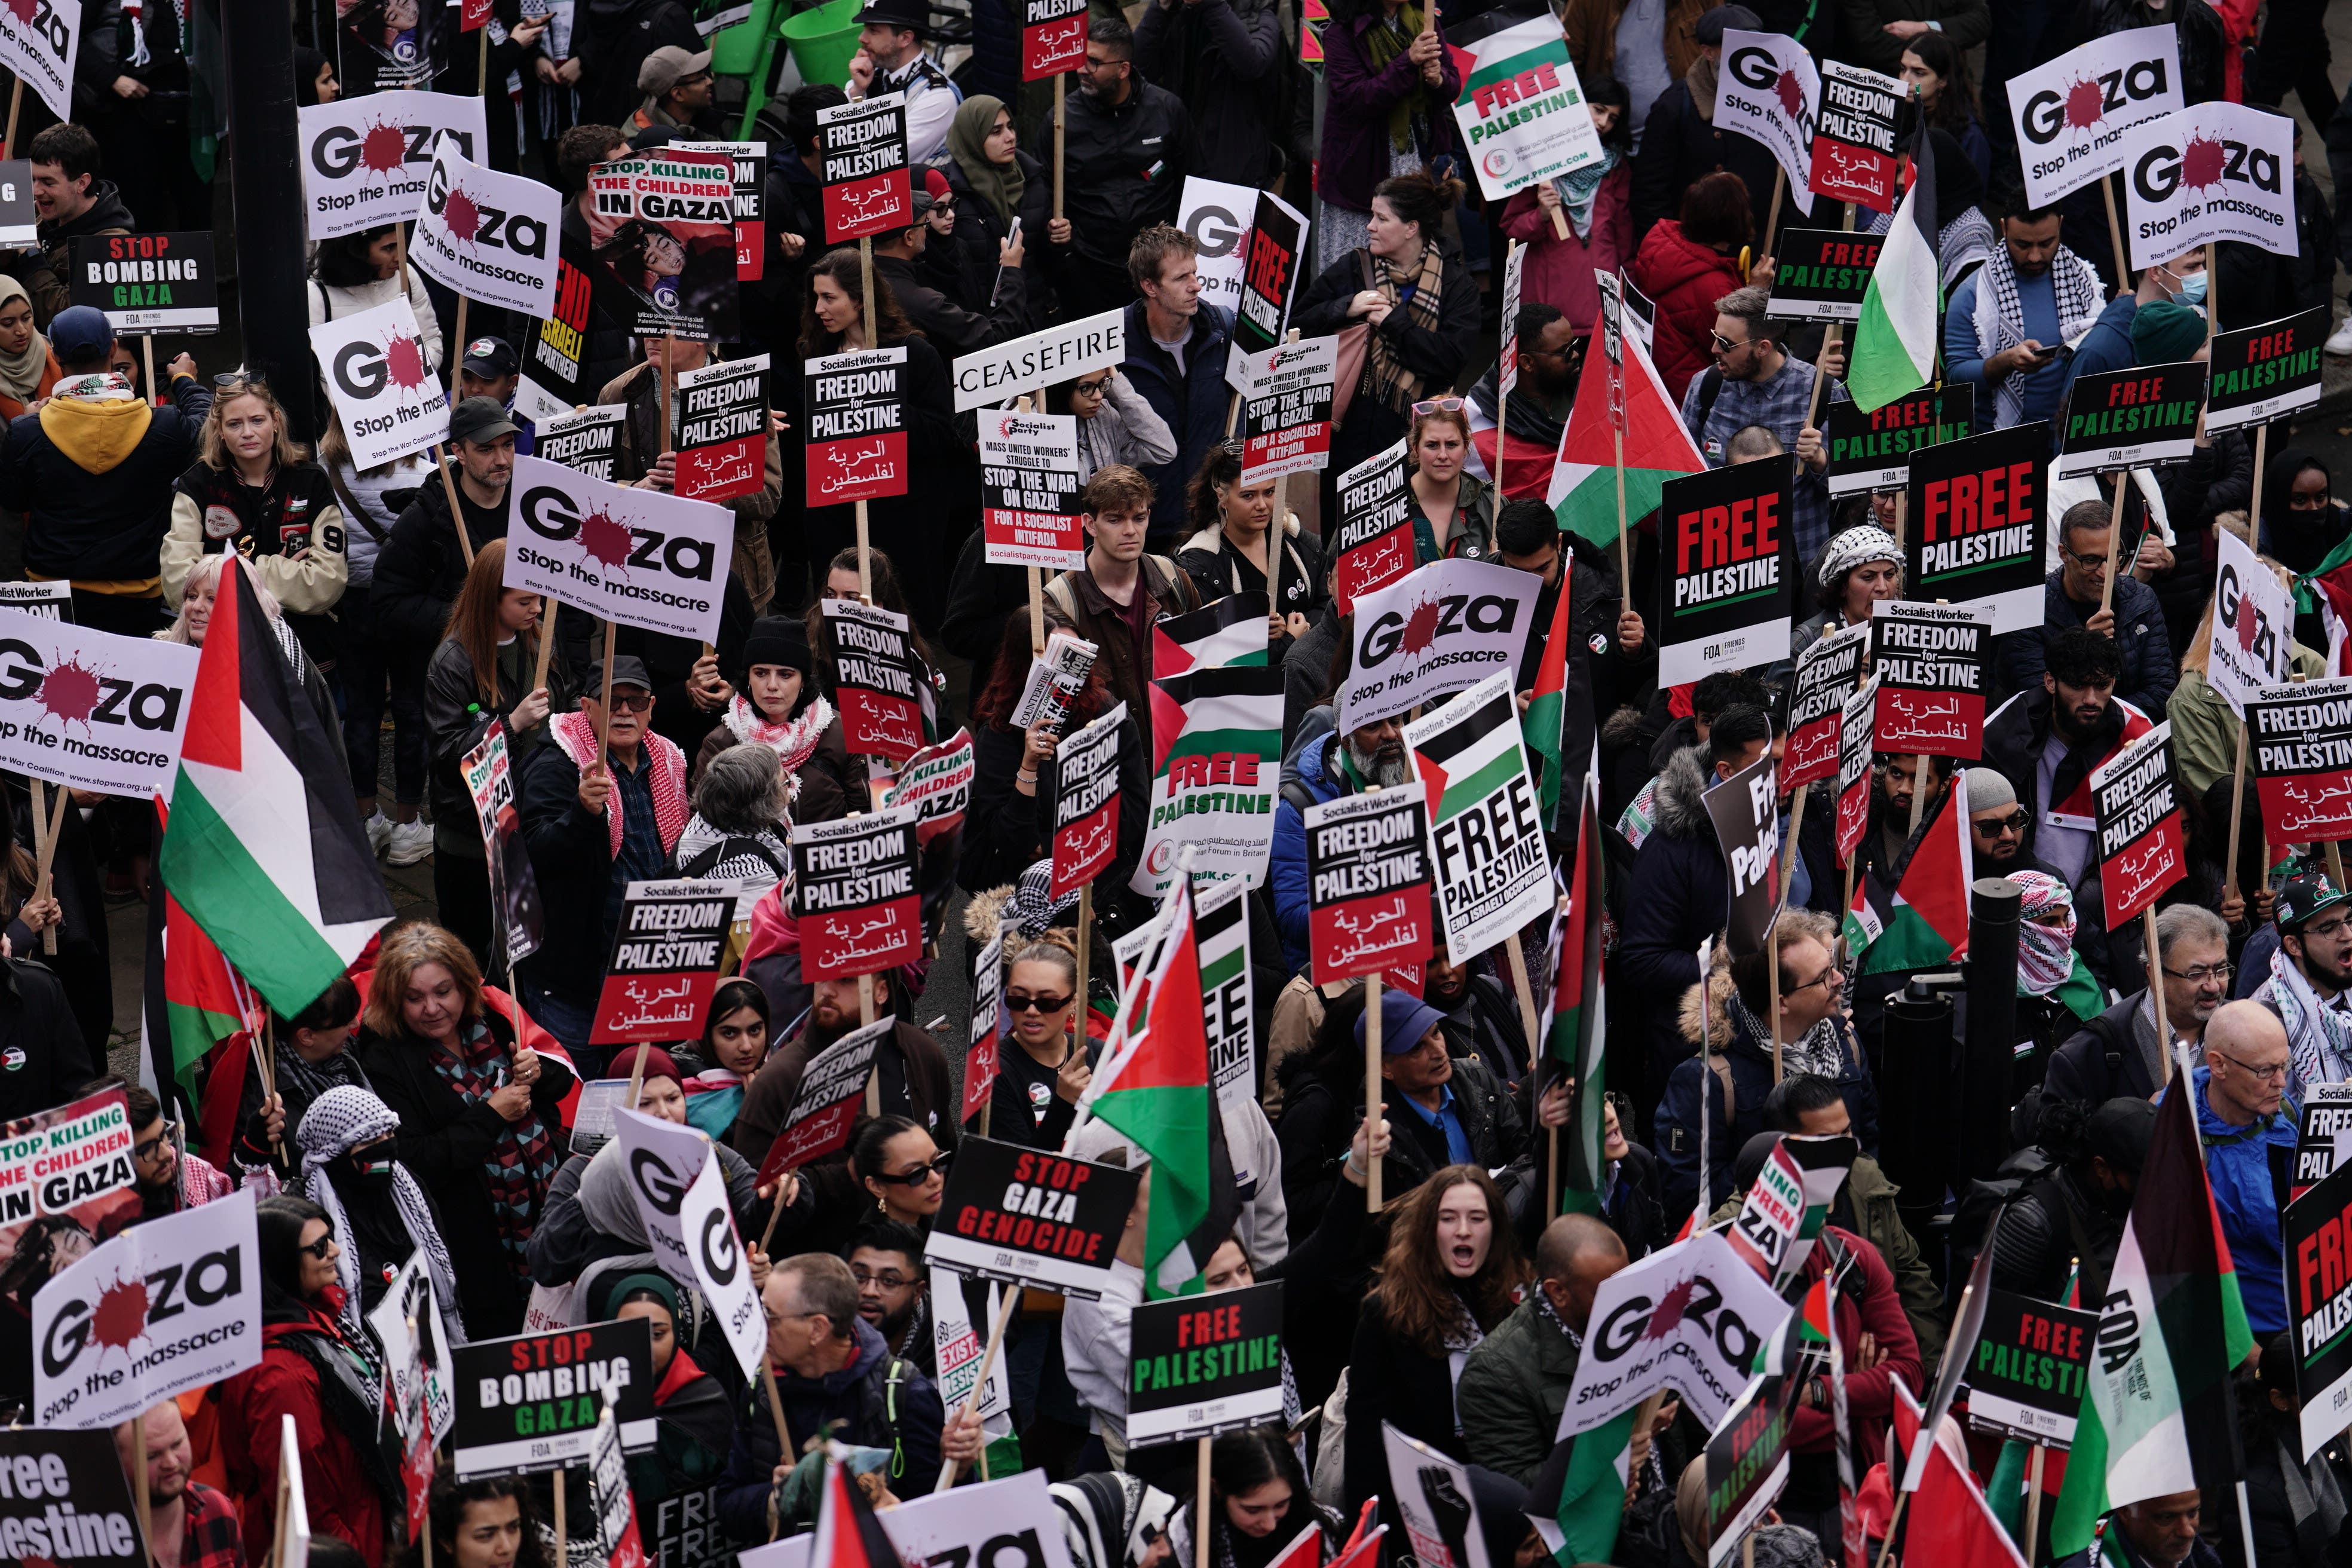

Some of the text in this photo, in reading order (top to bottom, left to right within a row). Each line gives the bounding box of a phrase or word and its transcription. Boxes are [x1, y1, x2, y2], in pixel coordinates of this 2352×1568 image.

[1038, 20, 1081, 44] الحرية
[18, 30, 66, 93] massacre
[1033, 41, 1084, 69] لفلسطين
[1471, 62, 1560, 118] FREE
[1828, 82, 1894, 120] FREEDOM
[1726, 93, 1787, 129] Stop the
[826, 113, 897, 148] FREEDOM
[651, 161, 727, 179] KILLING
[1504, 151, 1588, 191] WWW.PFBUK.COM
[2033, 143, 2090, 179] Stop the
[2080, 164, 2105, 182] Coalition
[2133, 140, 2281, 203] Gza
[317, 186, 385, 213] Stop the
[593, 177, 730, 197] THE CHILDREN
[368, 212, 397, 224] Coalition
[599, 194, 732, 221] IN GAZA
[2180, 200, 2284, 227] the massacre
[109, 236, 170, 258] STOP
[418, 218, 544, 290] Stop massacre
[1820, 242, 1877, 267] FREE
[2218, 228, 2278, 247] www.stopwar.org.uk
[87, 258, 198, 284] BOMBING
[1247, 227, 1290, 304] FREE
[113, 284, 173, 307] GAZA
[439, 270, 534, 309] Coalition www.stopwar.org.uk
[553, 258, 591, 333] END
[541, 318, 583, 358] ISRAELI
[2247, 329, 2294, 363] FREE
[535, 338, 578, 384] APARTHEID
[959, 326, 1120, 393] CEASEFIRE
[2213, 347, 2319, 397] PALESTINE
[688, 376, 760, 413] FREEDOM
[815, 370, 896, 401] FREEDOM
[1254, 371, 1296, 387] MASS UNITED
[2108, 376, 2164, 408] FREE
[353, 402, 421, 437] Stop the
[1248, 387, 1331, 419] STOP THE WAR
[1261, 405, 1313, 432] ON GAZA!
[2251, 403, 2263, 417] FOA
[1008, 425, 1039, 436] Party
[1012, 418, 1056, 431] Socialist
[1251, 437, 1269, 451] FOR
[1278, 424, 1323, 443] SOCIALIST
[542, 427, 613, 460] FREEDOM
[1006, 455, 1040, 467] STRUGGLE
[1034, 445, 1071, 458] WORKERS'
[1266, 441, 1305, 461] INTIFADA
[985, 467, 1077, 492] STOP THE WAR
[1244, 457, 1313, 481] socialistparty.org.uk
[1003, 489, 1060, 511] ON GAZA!
[1344, 465, 1404, 510] FREEDOM
[1924, 461, 2033, 541] FREE
[1015, 529, 1056, 547] INTIFADA
[1024, 514, 1072, 531] SOCIALIST
[1340, 497, 1409, 549] PALESTINE
[1678, 492, 1778, 575] FREE
[517, 547, 710, 612] Stop the massacre
[1674, 556, 1780, 607] PALESTINE
[576, 593, 697, 633] Coalition www.stopwar.org.uk
[1725, 638, 1745, 650] FRIENDS
[1882, 622, 1978, 652] FREEDOM
[1922, 649, 1938, 660] for
[2214, 637, 2231, 670] Stop
[838, 659, 914, 697] PALESTINE
[1389, 668, 1414, 690] the
[1417, 648, 1508, 678] massacre
[1797, 647, 1857, 695] FREEDOM
[1020, 670, 1052, 725] COUNTERFIRE
[1350, 682, 1383, 707] Stop
[1409, 678, 1508, 742] Palestine Solidarity Campaign
[23, 724, 169, 768] the massacre
[2302, 731, 2319, 743] for
[914, 745, 972, 783] KILLING
[1061, 731, 1118, 786] FREEDOM
[69, 774, 154, 793] www.stopwar.org.uk
[901, 765, 972, 803] CHILDREN
[1057, 765, 1119, 827] PALESTINE
[2133, 795, 2143, 807] for
[1153, 793, 1272, 829] PALESTINE
[2103, 783, 2174, 855] PALESTINE
[1435, 775, 1537, 887] FREE
[806, 830, 904, 872] FREEDOM
[1208, 847, 1231, 856] Forum
[1359, 849, 1377, 864] for
[851, 866, 868, 879] for
[1316, 857, 1423, 904] PALESTINE
[1443, 834, 1543, 910] PALESTINE
[1203, 883, 1242, 911] Campaign
[1450, 865, 1546, 935] END ISRAELI OCCUPATION
[2314, 884, 2341, 901] Gaza
[629, 902, 724, 930] FREEDOM
[1471, 895, 1536, 941] www.palestinecampaign.org
[615, 941, 720, 969] PALESTINE
[51, 1107, 123, 1147] KILLING
[34, 1129, 129, 1177] CHILDREN
[1016, 1152, 1091, 1186] STOP
[43, 1156, 132, 1208] GAZA
[1003, 1183, 1077, 1224] GAZA
[957, 1205, 1102, 1261] GENOCIDE
[41, 1244, 243, 1379] Gza
[1178, 1305, 1241, 1348] FREE
[1593, 1276, 1761, 1380] Gza
[512, 1331, 593, 1371] STOP
[2019, 1313, 2083, 1360] FREE
[1134, 1334, 1279, 1394] PALESTINE
[43, 1367, 124, 1425] Stop the
[479, 1356, 630, 1409] BOMBING
[1576, 1364, 1653, 1405] Stop the
[98, 1400, 143, 1419] Coalition
[514, 1397, 595, 1435] GAZA
[2020, 1410, 2034, 1426] FOA
[531, 1441, 550, 1457] FOA
